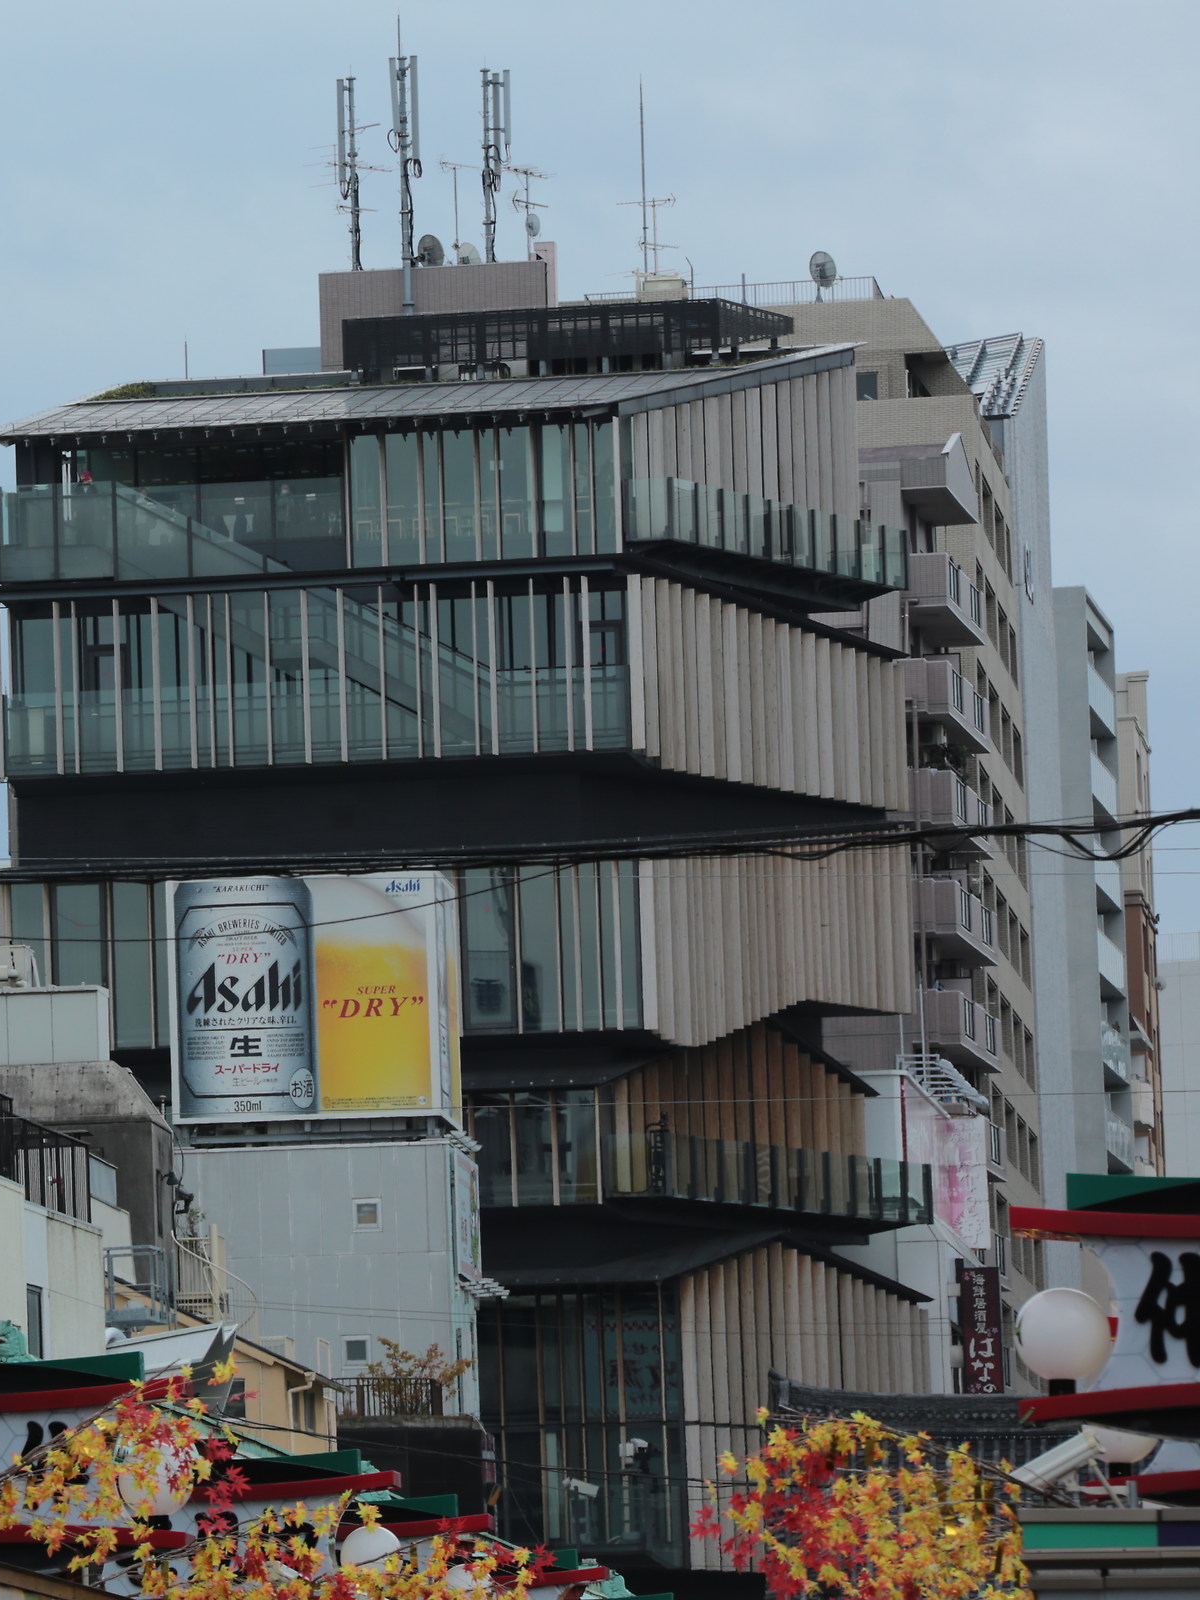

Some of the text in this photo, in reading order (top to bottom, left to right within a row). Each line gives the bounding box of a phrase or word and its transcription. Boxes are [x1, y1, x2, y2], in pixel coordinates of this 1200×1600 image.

[385, 878, 420, 893] Asahi
[197, 918, 288, 948] ASAHI BREWERIES LIMITED
[186, 958, 302, 1015] Asahi
[356, 985, 396, 995] SUPER
[230, 1035, 262, 1058] 生
[214, 1063, 280, 1075] スーパードライ
[291, 1080, 313, 1098] お酒
[234, 1100, 262, 1112] 350ml
[972, 1274, 987, 1334] 海鮮居酒屋
[969, 1338, 997, 1393] はなの
